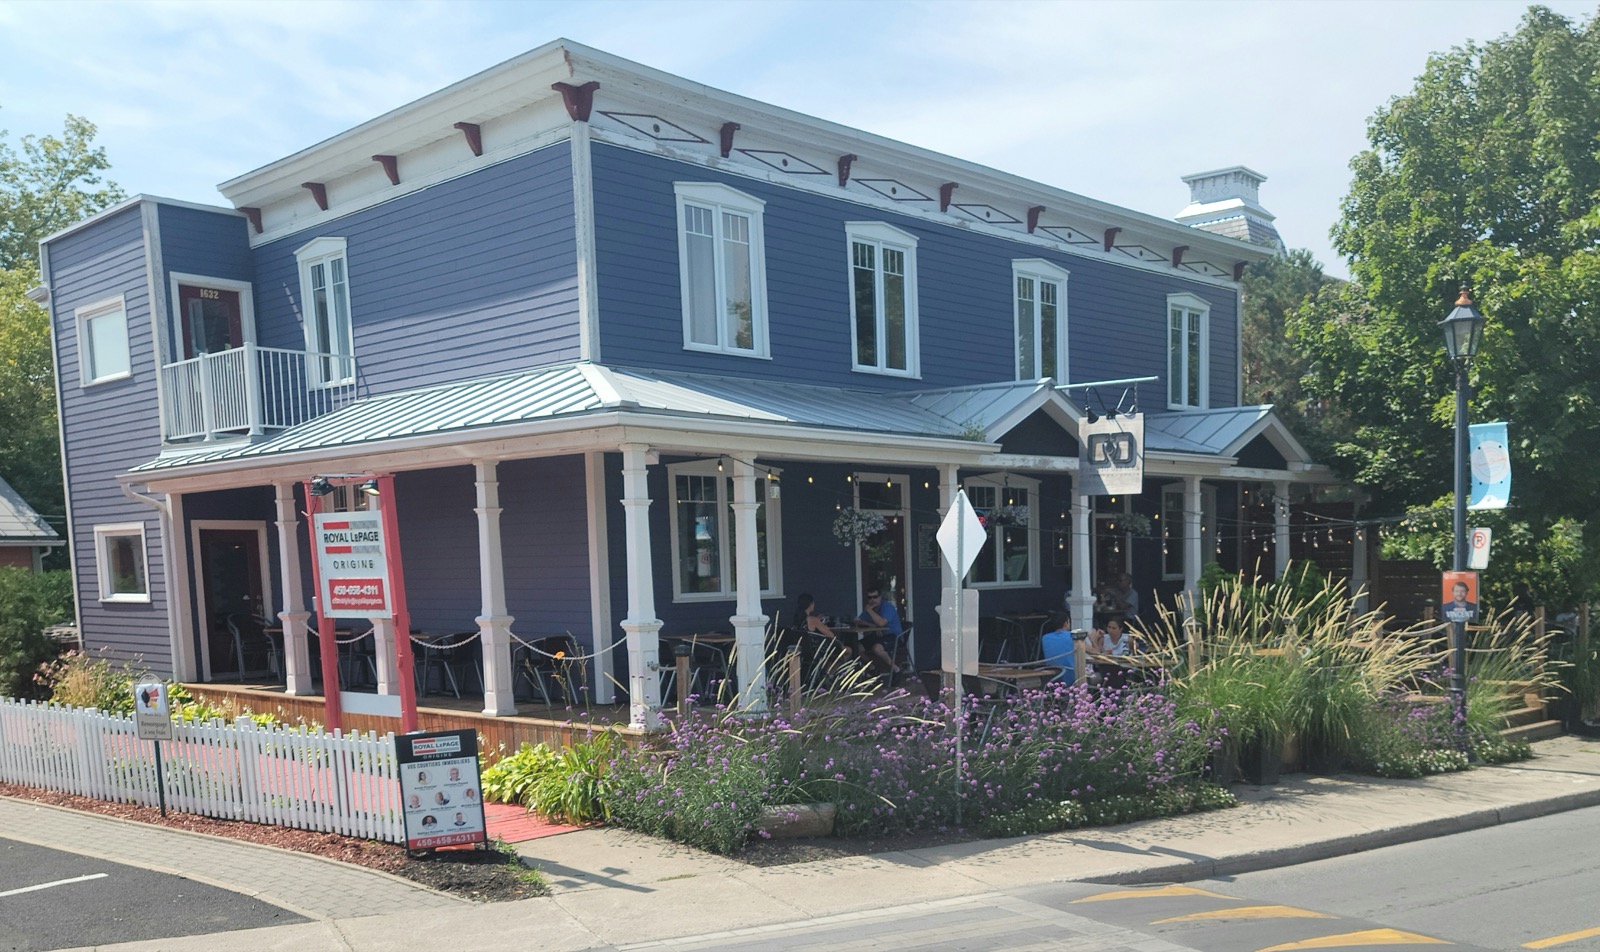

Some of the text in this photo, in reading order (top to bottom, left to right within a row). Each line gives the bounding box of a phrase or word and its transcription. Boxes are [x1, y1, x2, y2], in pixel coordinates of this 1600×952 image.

[200, 289, 219, 299] 1632
[324, 532, 348, 543] ROYAL
[333, 560, 375, 569] ORIGINE
[442, 758, 471, 766] IMMOBILIERS
[416, 833, 476, 847] 450-658-4311
